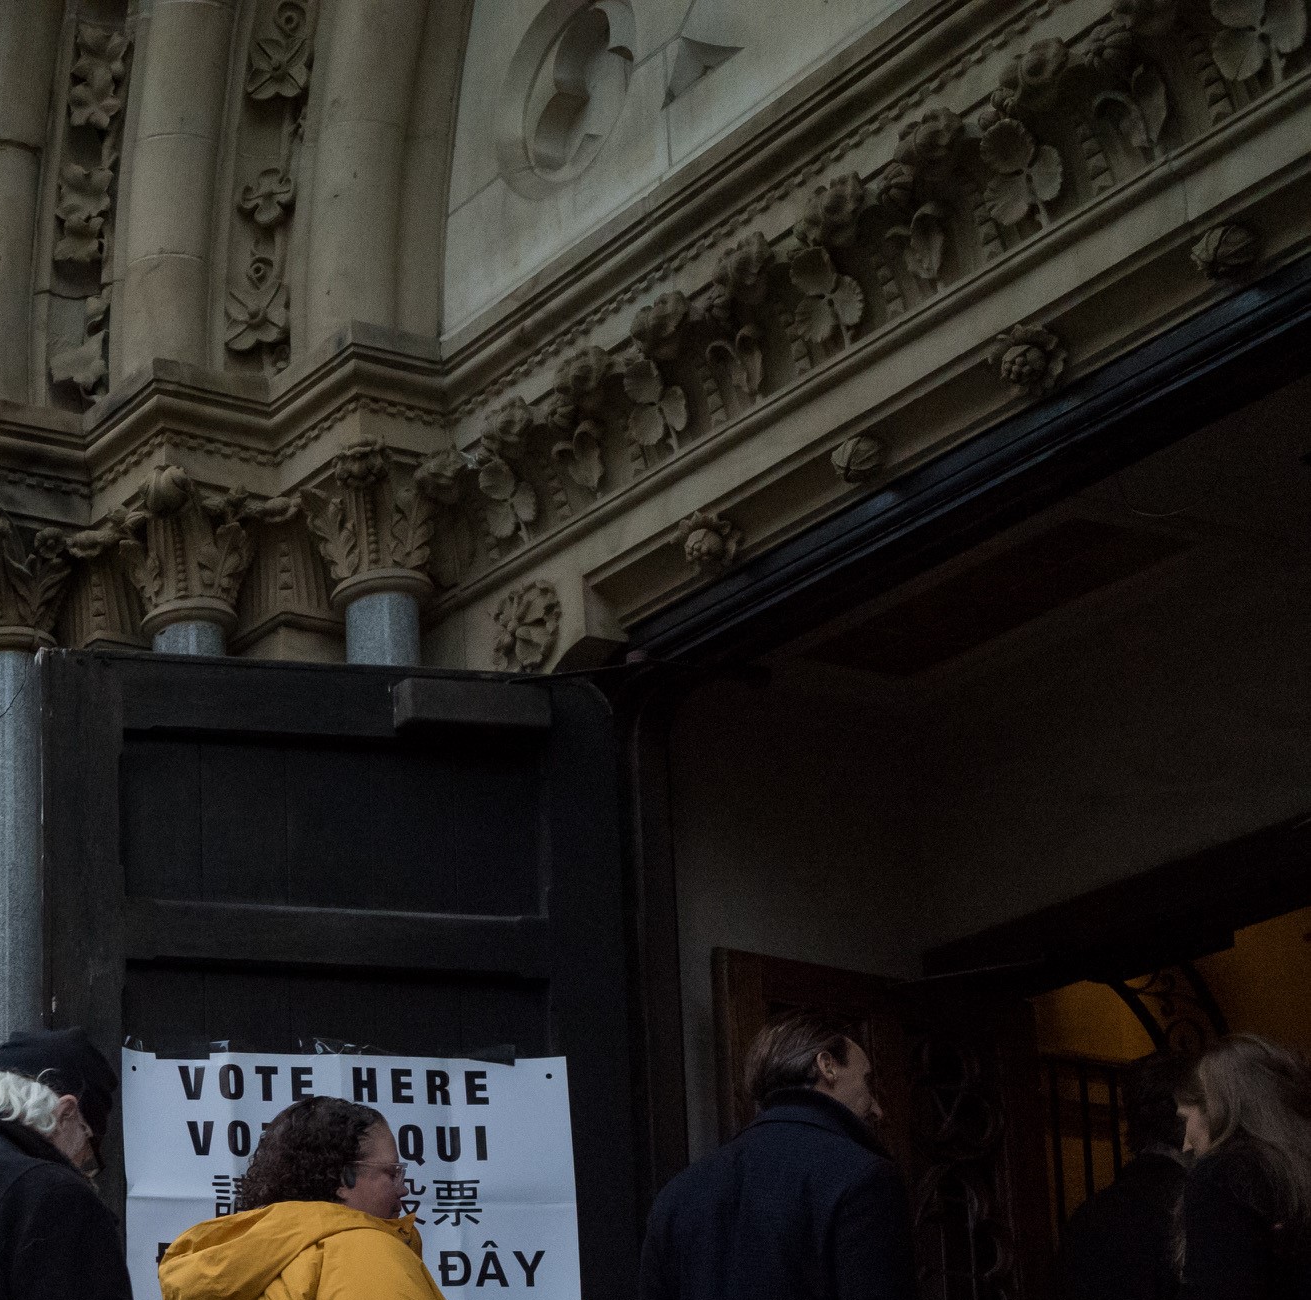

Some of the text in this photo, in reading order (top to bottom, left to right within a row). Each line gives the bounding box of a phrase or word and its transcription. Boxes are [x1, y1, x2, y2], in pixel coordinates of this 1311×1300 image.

[177, 1063, 491, 1106] VOTE HERE
[186, 1120, 273, 1157] VO
[438, 1240, 546, 1288] ĐÂY
